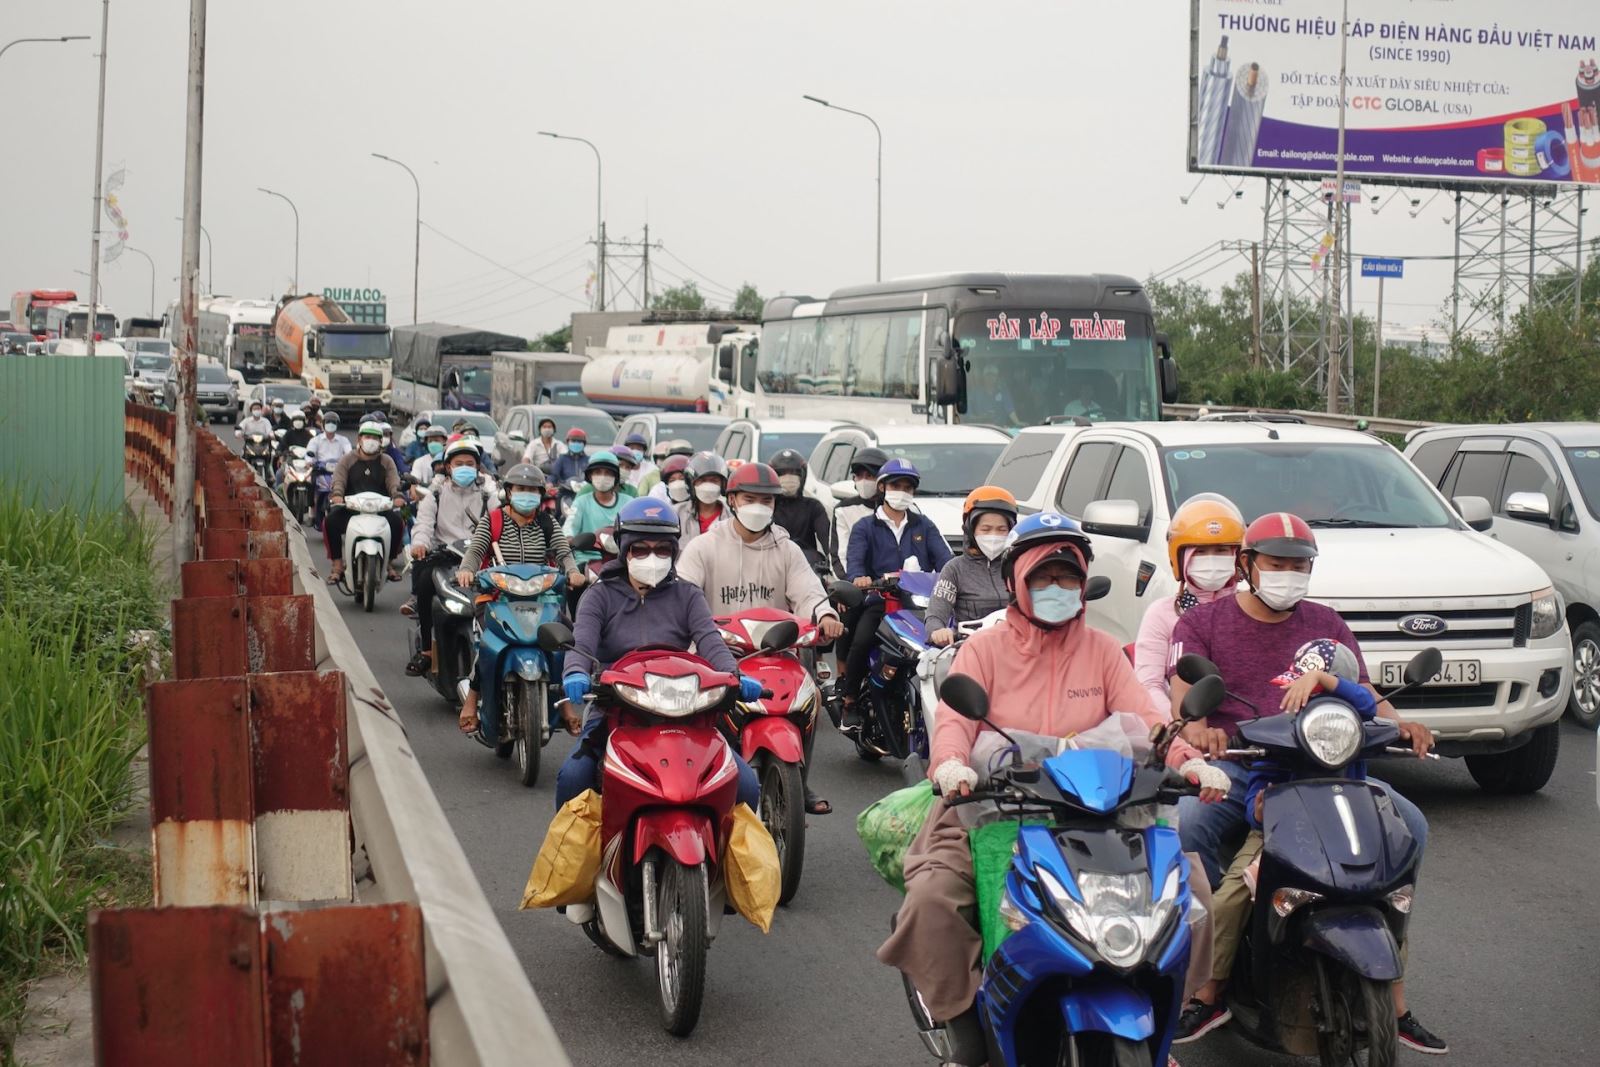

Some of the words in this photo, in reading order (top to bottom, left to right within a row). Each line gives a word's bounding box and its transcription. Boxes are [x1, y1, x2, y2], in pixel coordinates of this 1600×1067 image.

[1218, 13, 1290, 34] THƯƠNG
[1296, 16, 1336, 39] HIỆU
[1379, 21, 1420, 43] ĐIỆN
[1425, 23, 1472, 44] HÀNG
[1517, 29, 1553, 51] VIỆT
[1558, 34, 1596, 51] NAM
[1369, 45, 1413, 61] (SINCE
[1416, 49, 1451, 65] 1990)
[1304, 72, 1328, 86] TÁC
[1356, 74, 1388, 88] XUẤT
[1414, 78, 1441, 91] SIÊU
[1443, 80, 1481, 96] NHIỆT
[1291, 93, 1314, 109] TẬP
[1352, 95, 1382, 110] CTC
[1384, 97, 1440, 112] GLOBAL
[1443, 102, 1473, 116] (USA)
[1257, 148, 1280, 158] Email:
[1280, 149, 1375, 162] dailong@dailongable.com
[1382, 154, 1413, 164] Website:
[1413, 155, 1475, 167] dailongcable.com
[323, 288, 381, 302] DUHACO
[987, 311, 1020, 340] TÂN
[1029, 311, 1061, 346] LẬP
[1070, 312, 1127, 341] THÀNH
[1411, 618, 1438, 630] Ford
